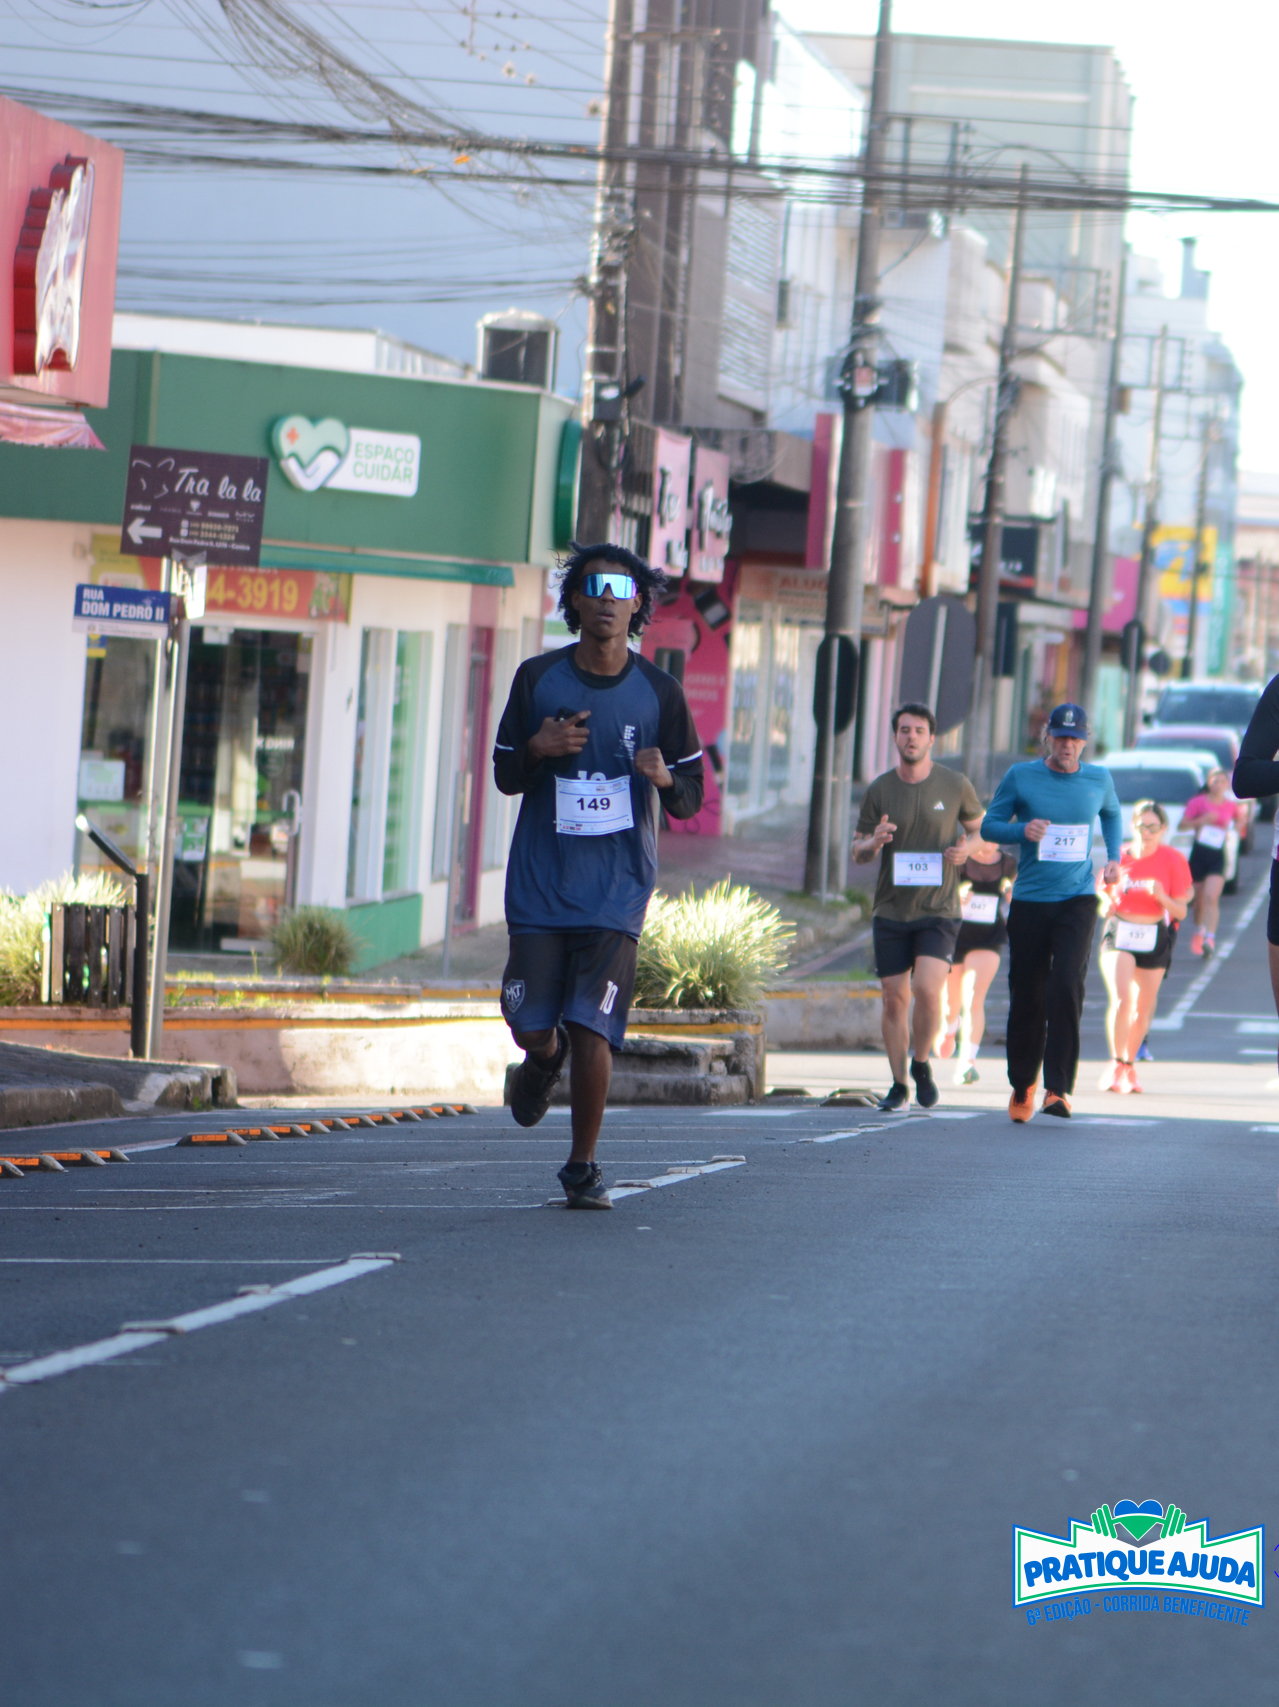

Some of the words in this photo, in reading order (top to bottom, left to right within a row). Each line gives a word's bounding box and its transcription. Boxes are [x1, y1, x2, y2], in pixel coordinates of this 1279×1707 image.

[353, 461, 413, 484] CUIDAR
[174, 467, 210, 496] Tra
[217, 475, 237, 500] la
[242, 477, 262, 502] la
[82, 587, 104, 601] RUA
[81, 601, 110, 617] DOM
[112, 603, 153, 621] PEDRO
[155, 606, 165, 621] II
[577, 797, 611, 811] 149
[1054, 836, 1077, 846] 217
[908, 862, 929, 872] 103
[1129, 931, 1146, 940] 137
[505, 984, 522, 1001] MKT
[600, 980, 619, 1015] 10
